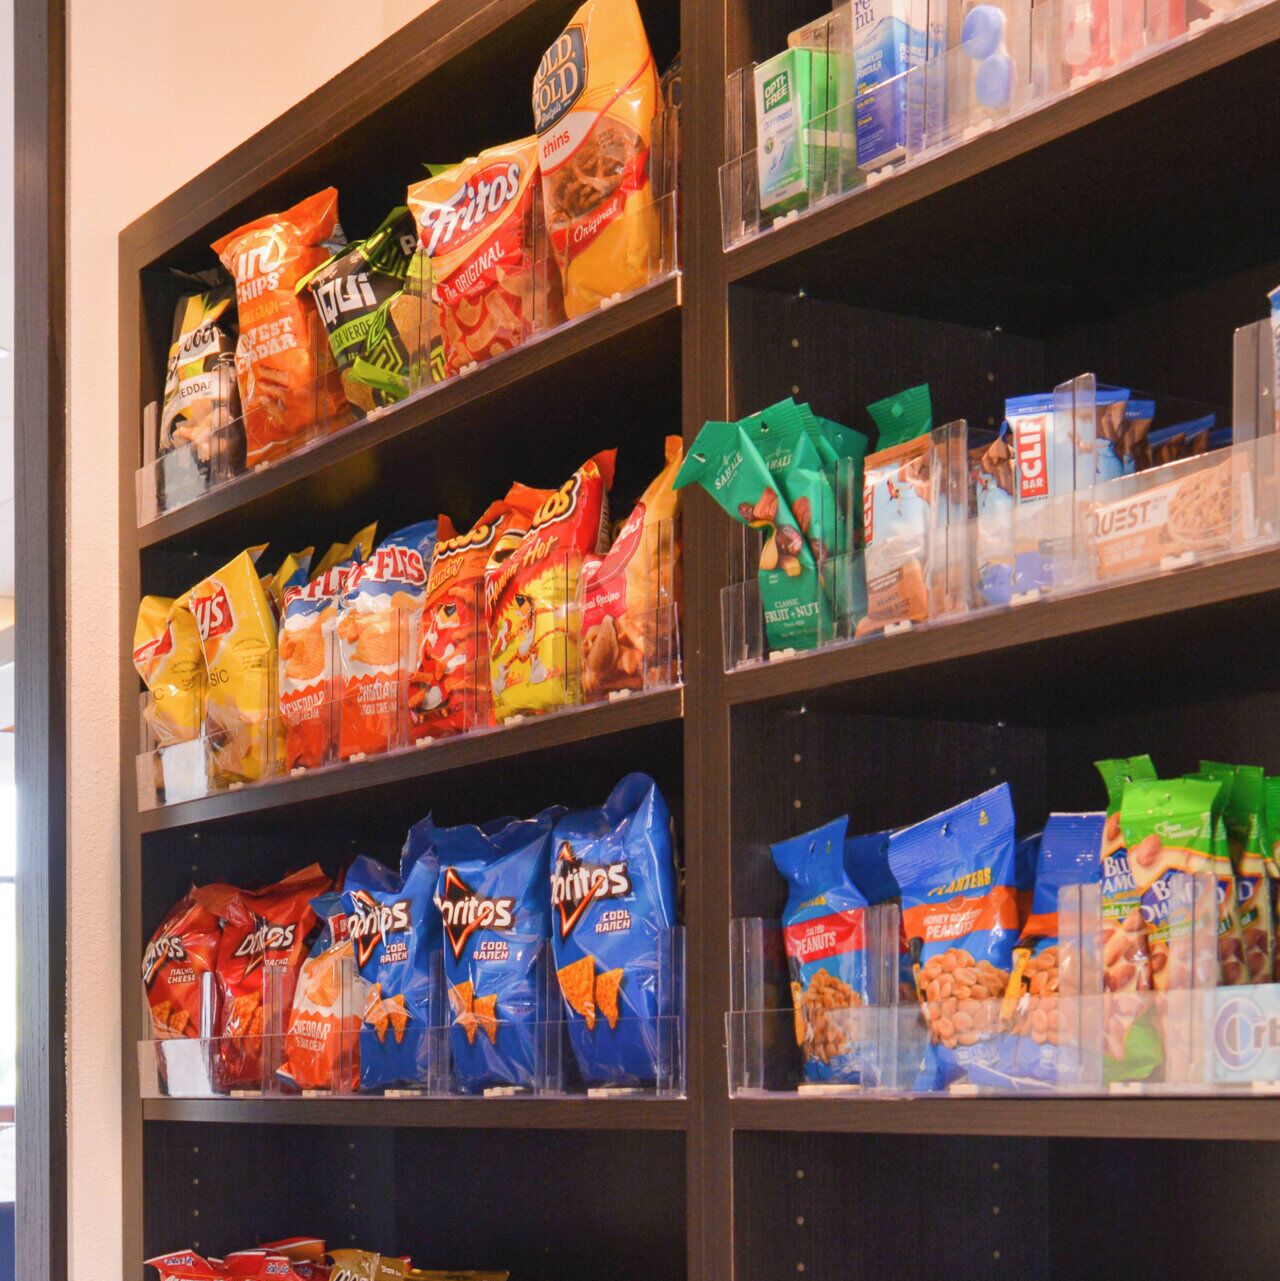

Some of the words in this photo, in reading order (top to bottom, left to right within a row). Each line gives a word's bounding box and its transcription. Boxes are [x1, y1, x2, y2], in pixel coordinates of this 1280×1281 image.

[855, 10, 875, 30] nu
[765, 85, 788, 110] FREE
[542, 130, 571, 159] thins
[420, 162, 521, 257] Fritos
[573, 198, 619, 244] Original
[455, 240, 506, 294] ORIGINAL
[1019, 420, 1042, 477] CLIF
[714, 451, 743, 490] SAHALE
[1022, 477, 1044, 490] BAR
[765, 605, 789, 623] FRUIT
[602, 909, 631, 922] COOL
[595, 918, 632, 935] RANCH
[385, 942, 408, 954] COOL
[480, 941, 509, 952] COOL
[796, 931, 837, 957] PEANUTS
[379, 952, 408, 965] RANCH
[473, 949, 509, 961] RANCH
[167, 974, 197, 985] CHEESE
